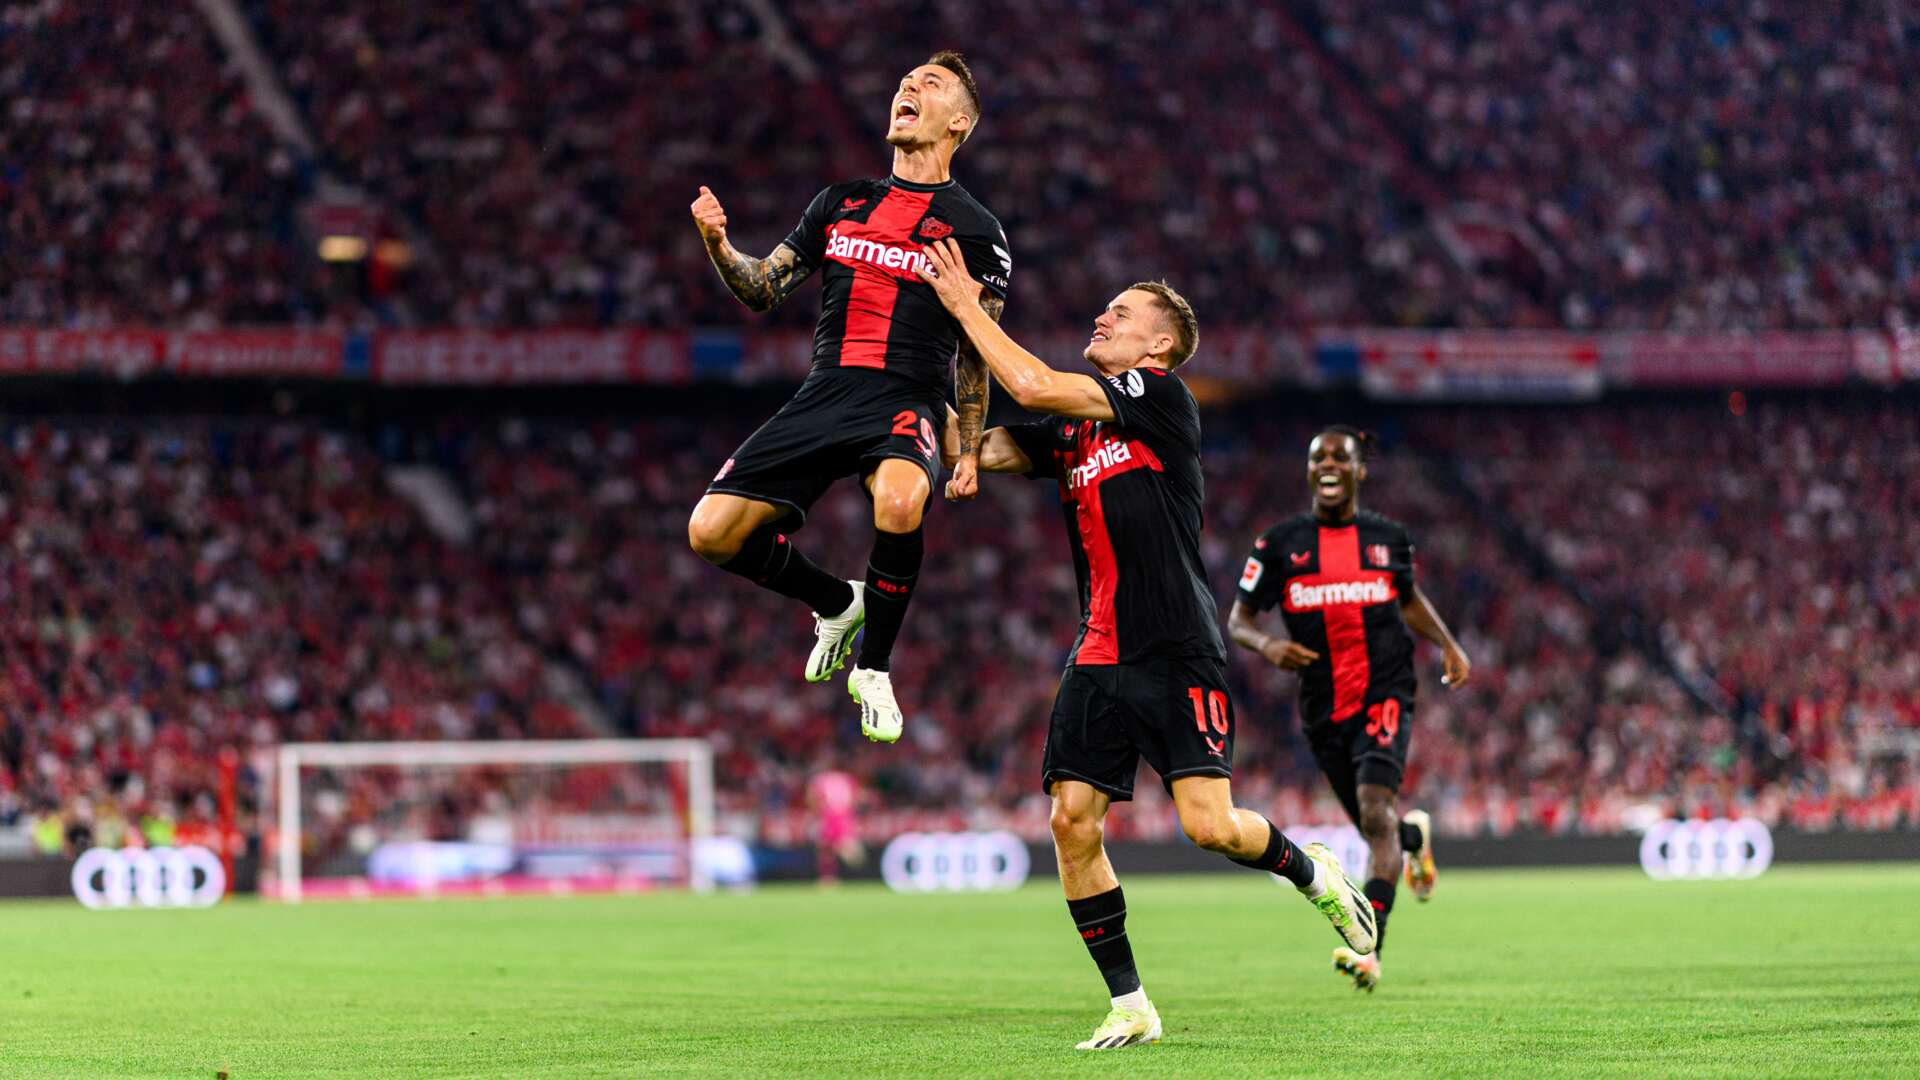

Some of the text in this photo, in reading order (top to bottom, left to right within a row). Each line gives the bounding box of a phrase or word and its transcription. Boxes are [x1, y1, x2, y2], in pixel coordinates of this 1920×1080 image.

[1289, 577, 1390, 607] Barmeni
[1188, 687, 1229, 735] 10
[1365, 698, 1399, 736] 30
